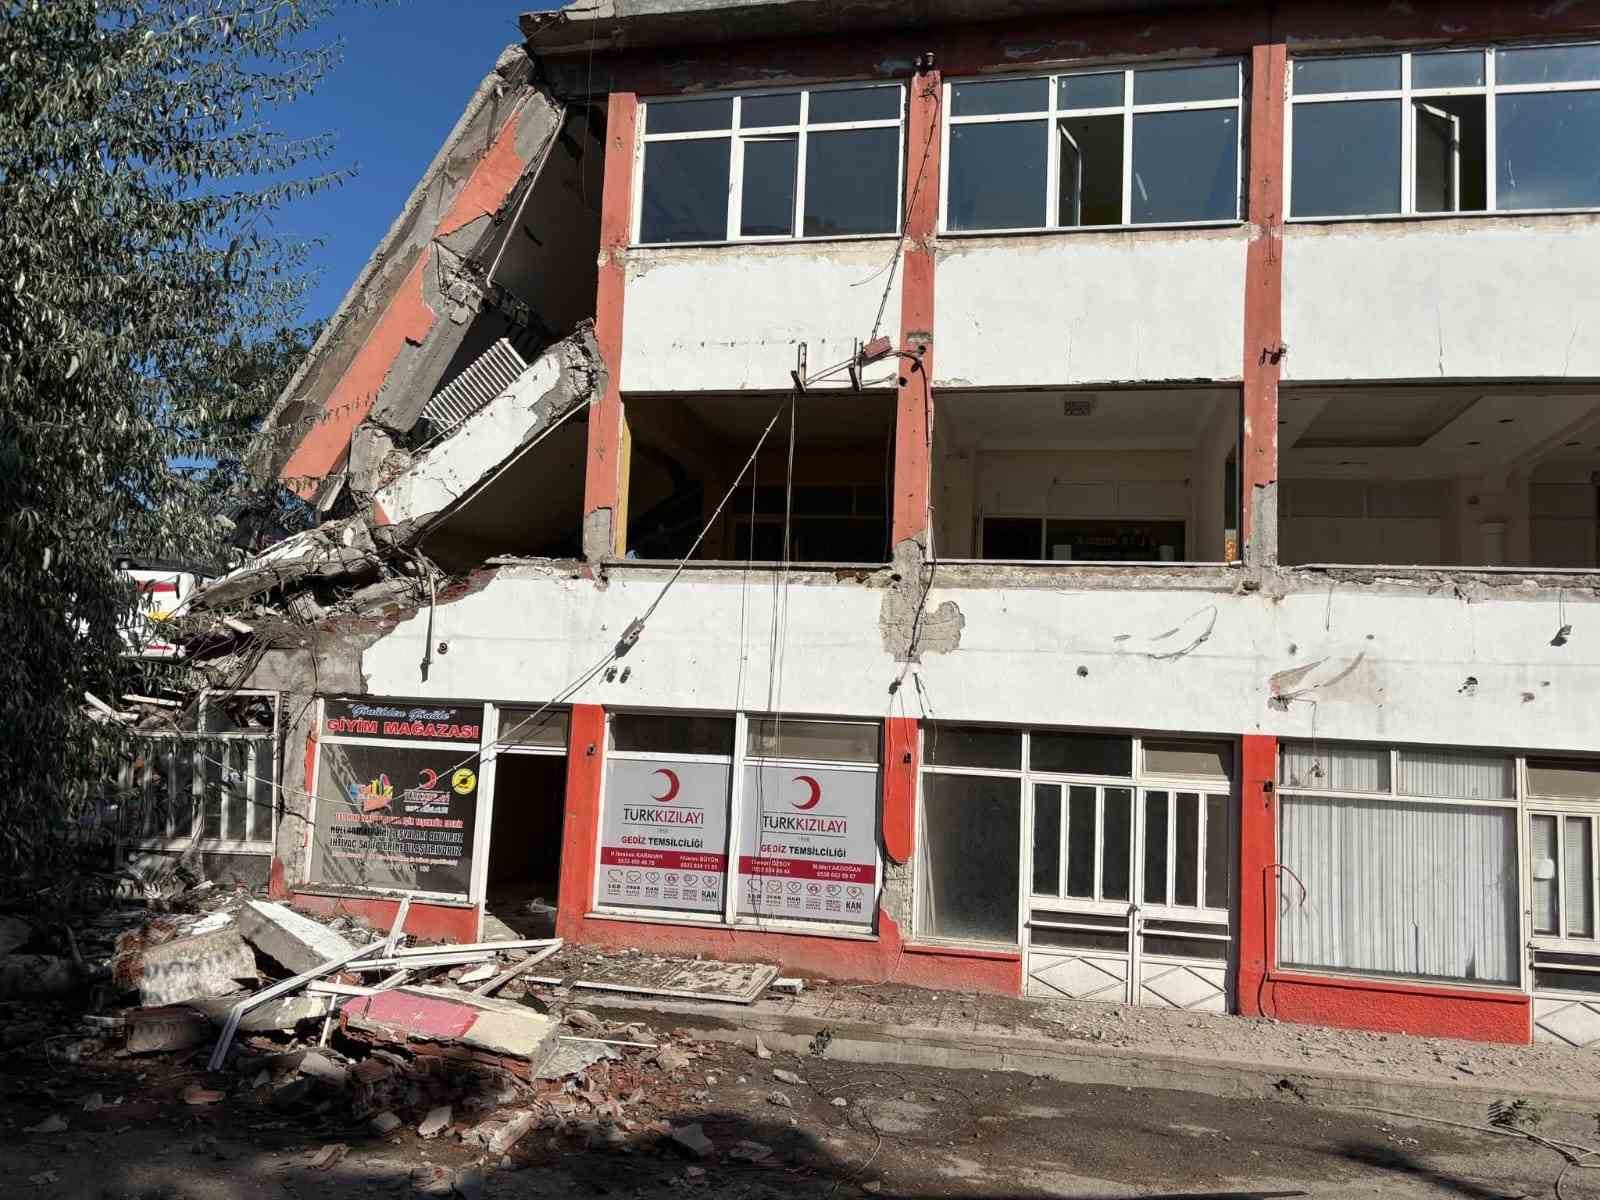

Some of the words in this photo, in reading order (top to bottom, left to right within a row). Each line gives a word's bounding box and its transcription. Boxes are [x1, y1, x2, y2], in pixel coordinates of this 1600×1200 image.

[327, 716, 377, 733] GİYİM
[383, 719, 480, 739] MAĞAZASI
[621, 835, 646, 845] GEDİZ
[760, 844, 786, 854] GEDİZ
